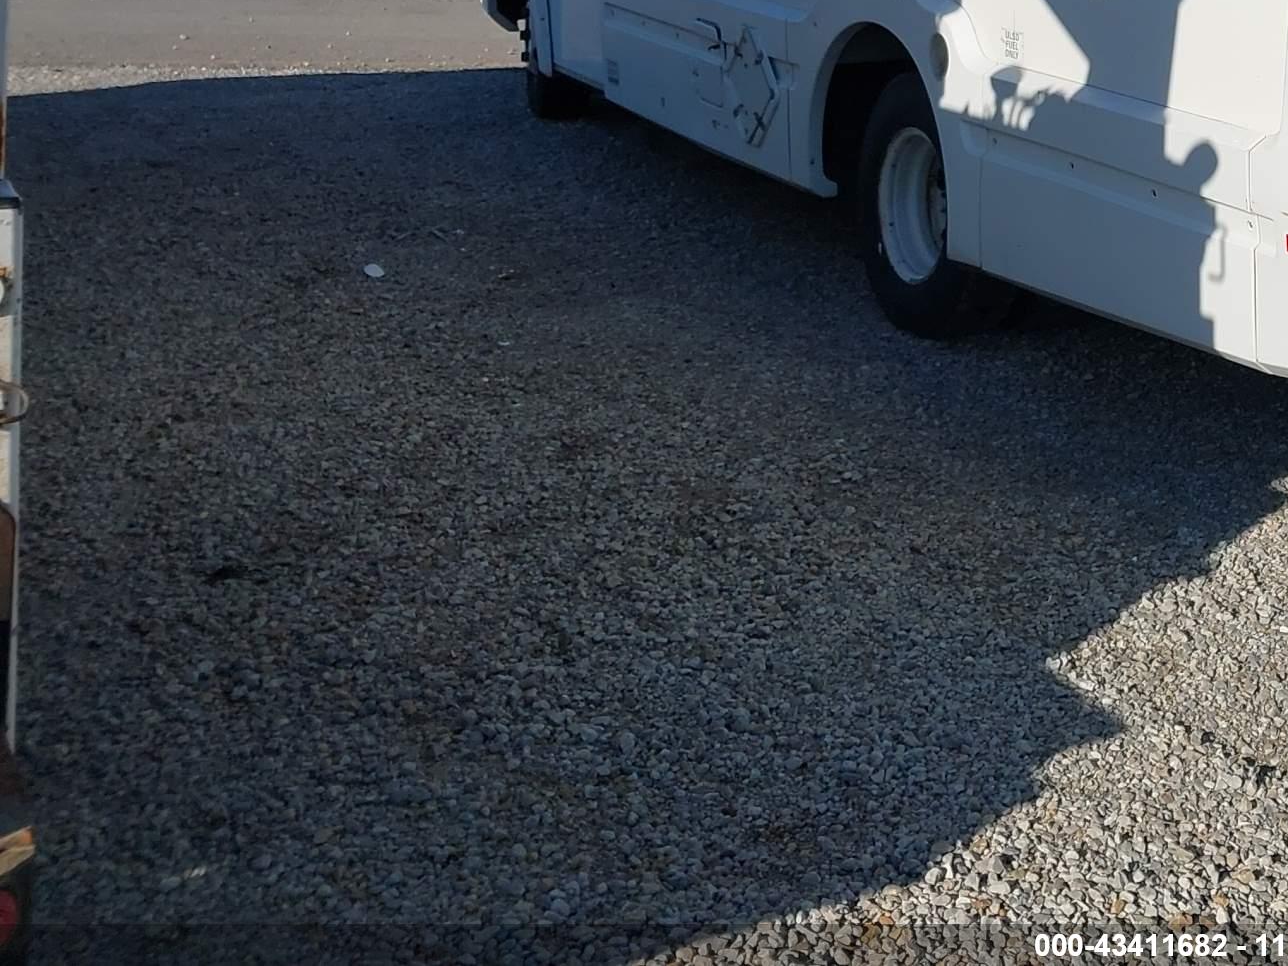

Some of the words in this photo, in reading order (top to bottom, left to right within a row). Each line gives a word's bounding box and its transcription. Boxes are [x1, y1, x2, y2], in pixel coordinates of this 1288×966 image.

[1004, 30, 1020, 41] ULSD
[1005, 40, 1019, 51] FUEL
[1005, 49, 1019, 59] ONLY
